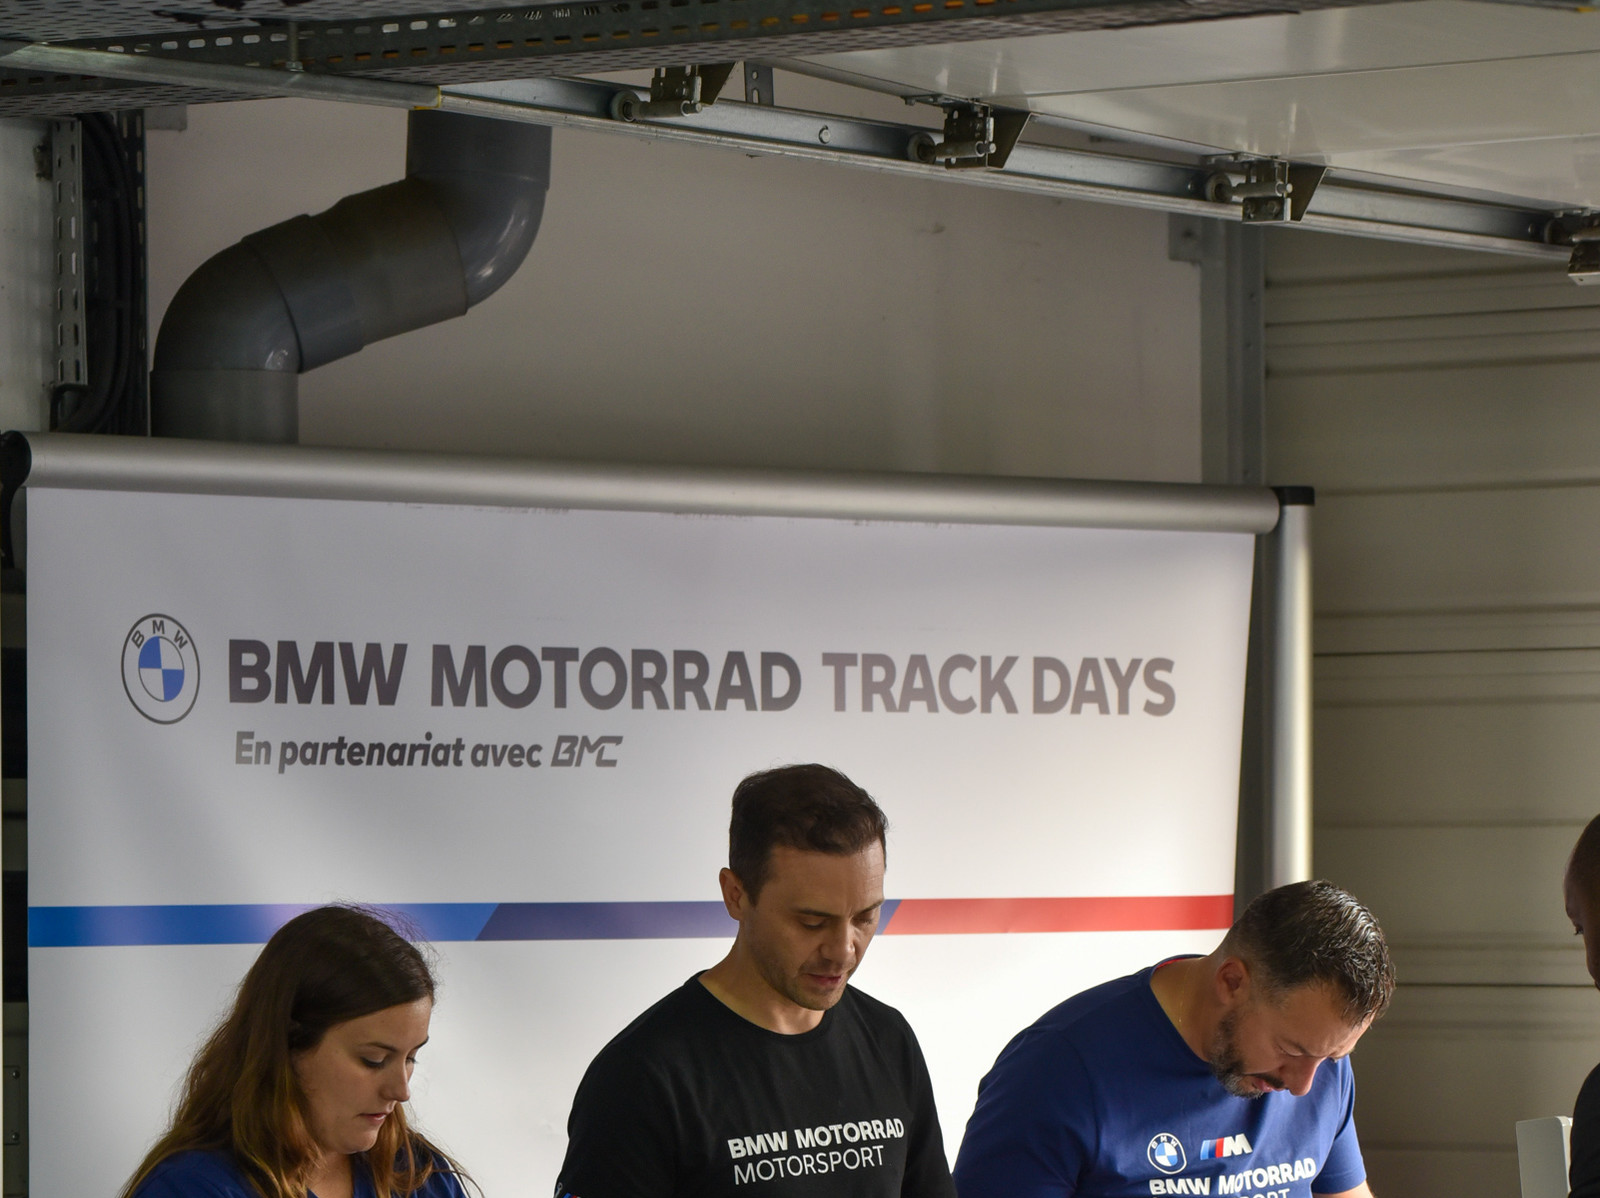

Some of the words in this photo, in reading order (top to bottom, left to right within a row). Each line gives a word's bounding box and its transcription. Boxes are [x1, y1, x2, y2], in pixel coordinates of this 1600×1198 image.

[130, 619, 190, 651] BMW
[228, 638, 408, 706] BMW
[430, 643, 802, 711] MOTORRAD
[821, 651, 1020, 715] TRACK
[1032, 655, 1177, 717] DAYS
[235, 731, 272, 765] En
[277, 732, 466, 774] partenariat
[470, 740, 542, 768] avec
[550, 735, 624, 768] BMC
[727, 1130, 789, 1159] BMW
[794, 1117, 905, 1149] MOTORRAD
[1151, 1135, 1179, 1149] BMW
[733, 1145, 885, 1185] MOTORSPORT
[1149, 1177, 1211, 1196] BMW
[1218, 1157, 1317, 1195] MOTORRAD
